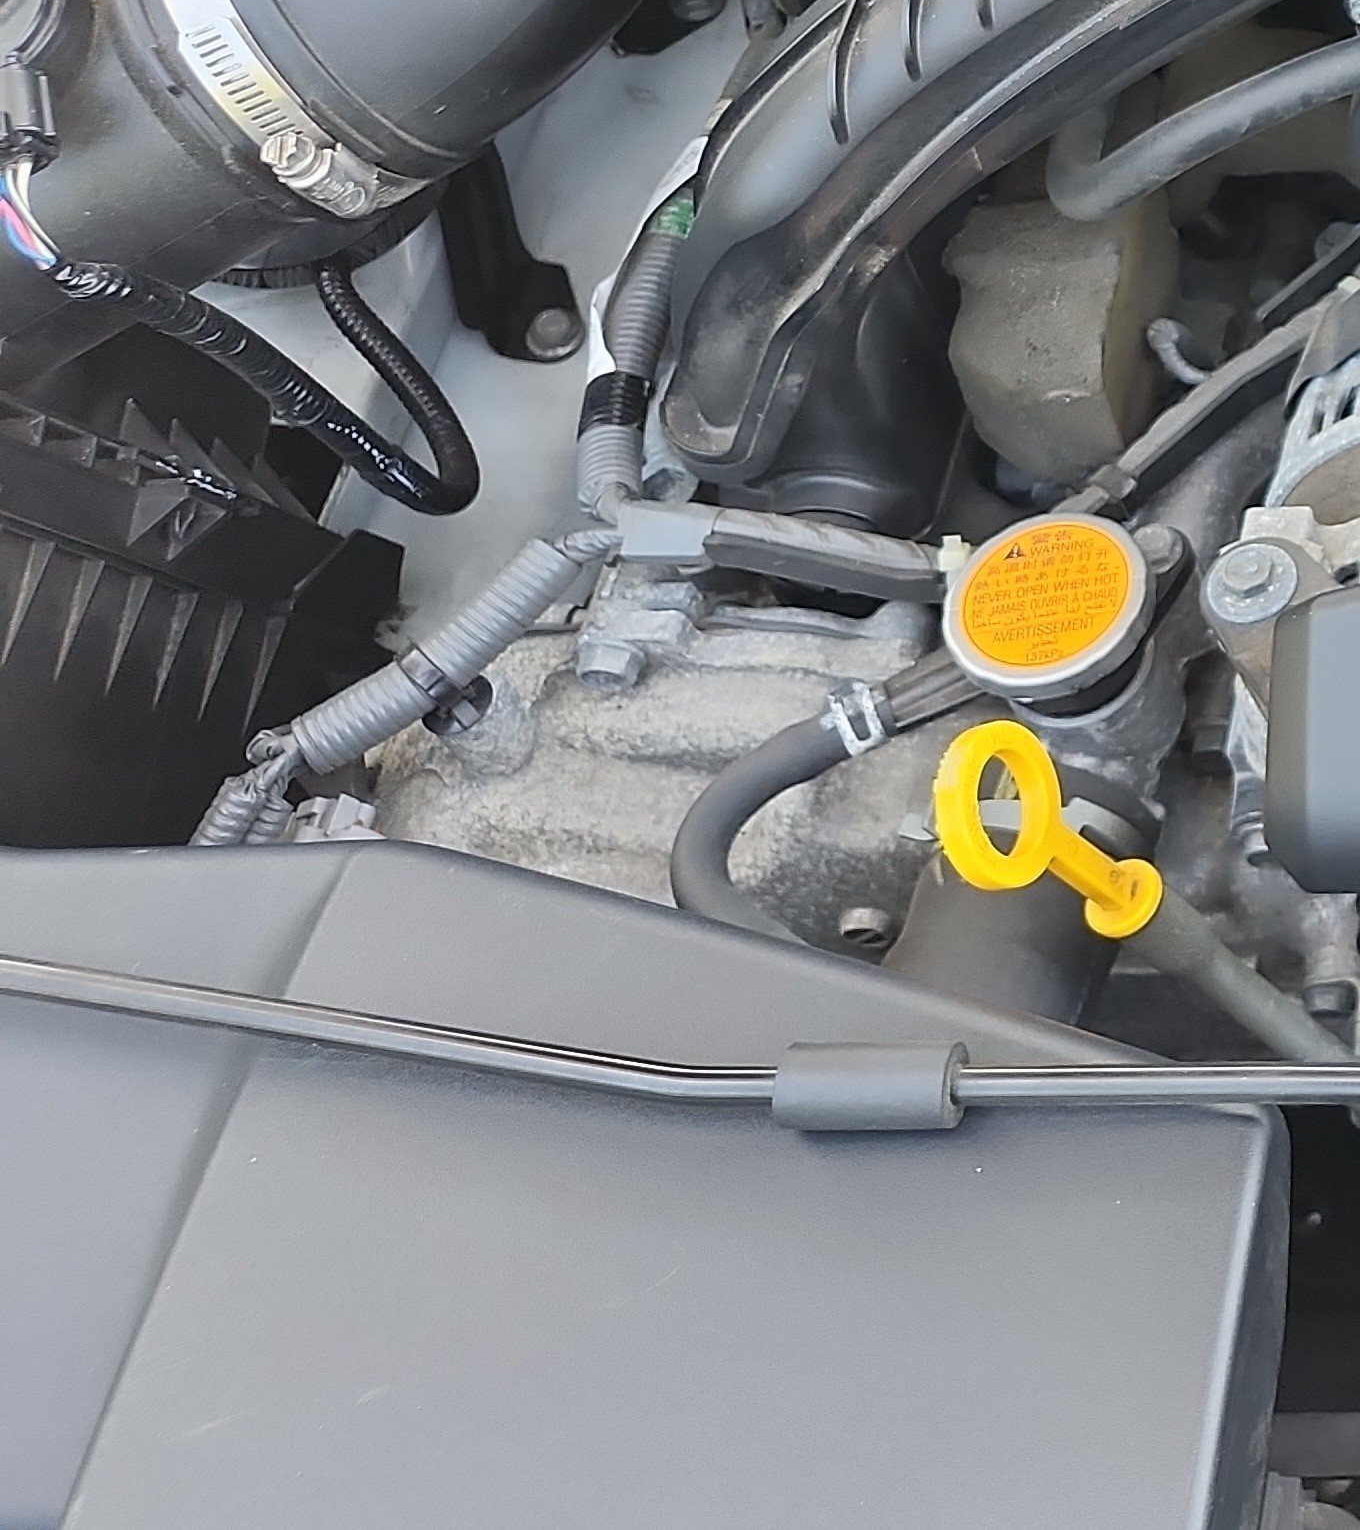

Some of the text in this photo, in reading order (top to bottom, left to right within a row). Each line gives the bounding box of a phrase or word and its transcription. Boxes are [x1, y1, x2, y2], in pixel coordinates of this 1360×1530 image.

[1030, 538, 1095, 556] WARNING
[973, 590, 1011, 607] NEVER
[1016, 584, 1049, 598] OPEN
[1053, 577, 1089, 592] WHEN
[990, 601, 1027, 616] JAMAIS
[1030, 594, 1068, 609] OUVRIR
[992, 617, 1095, 643] AVERTISSEMENT
